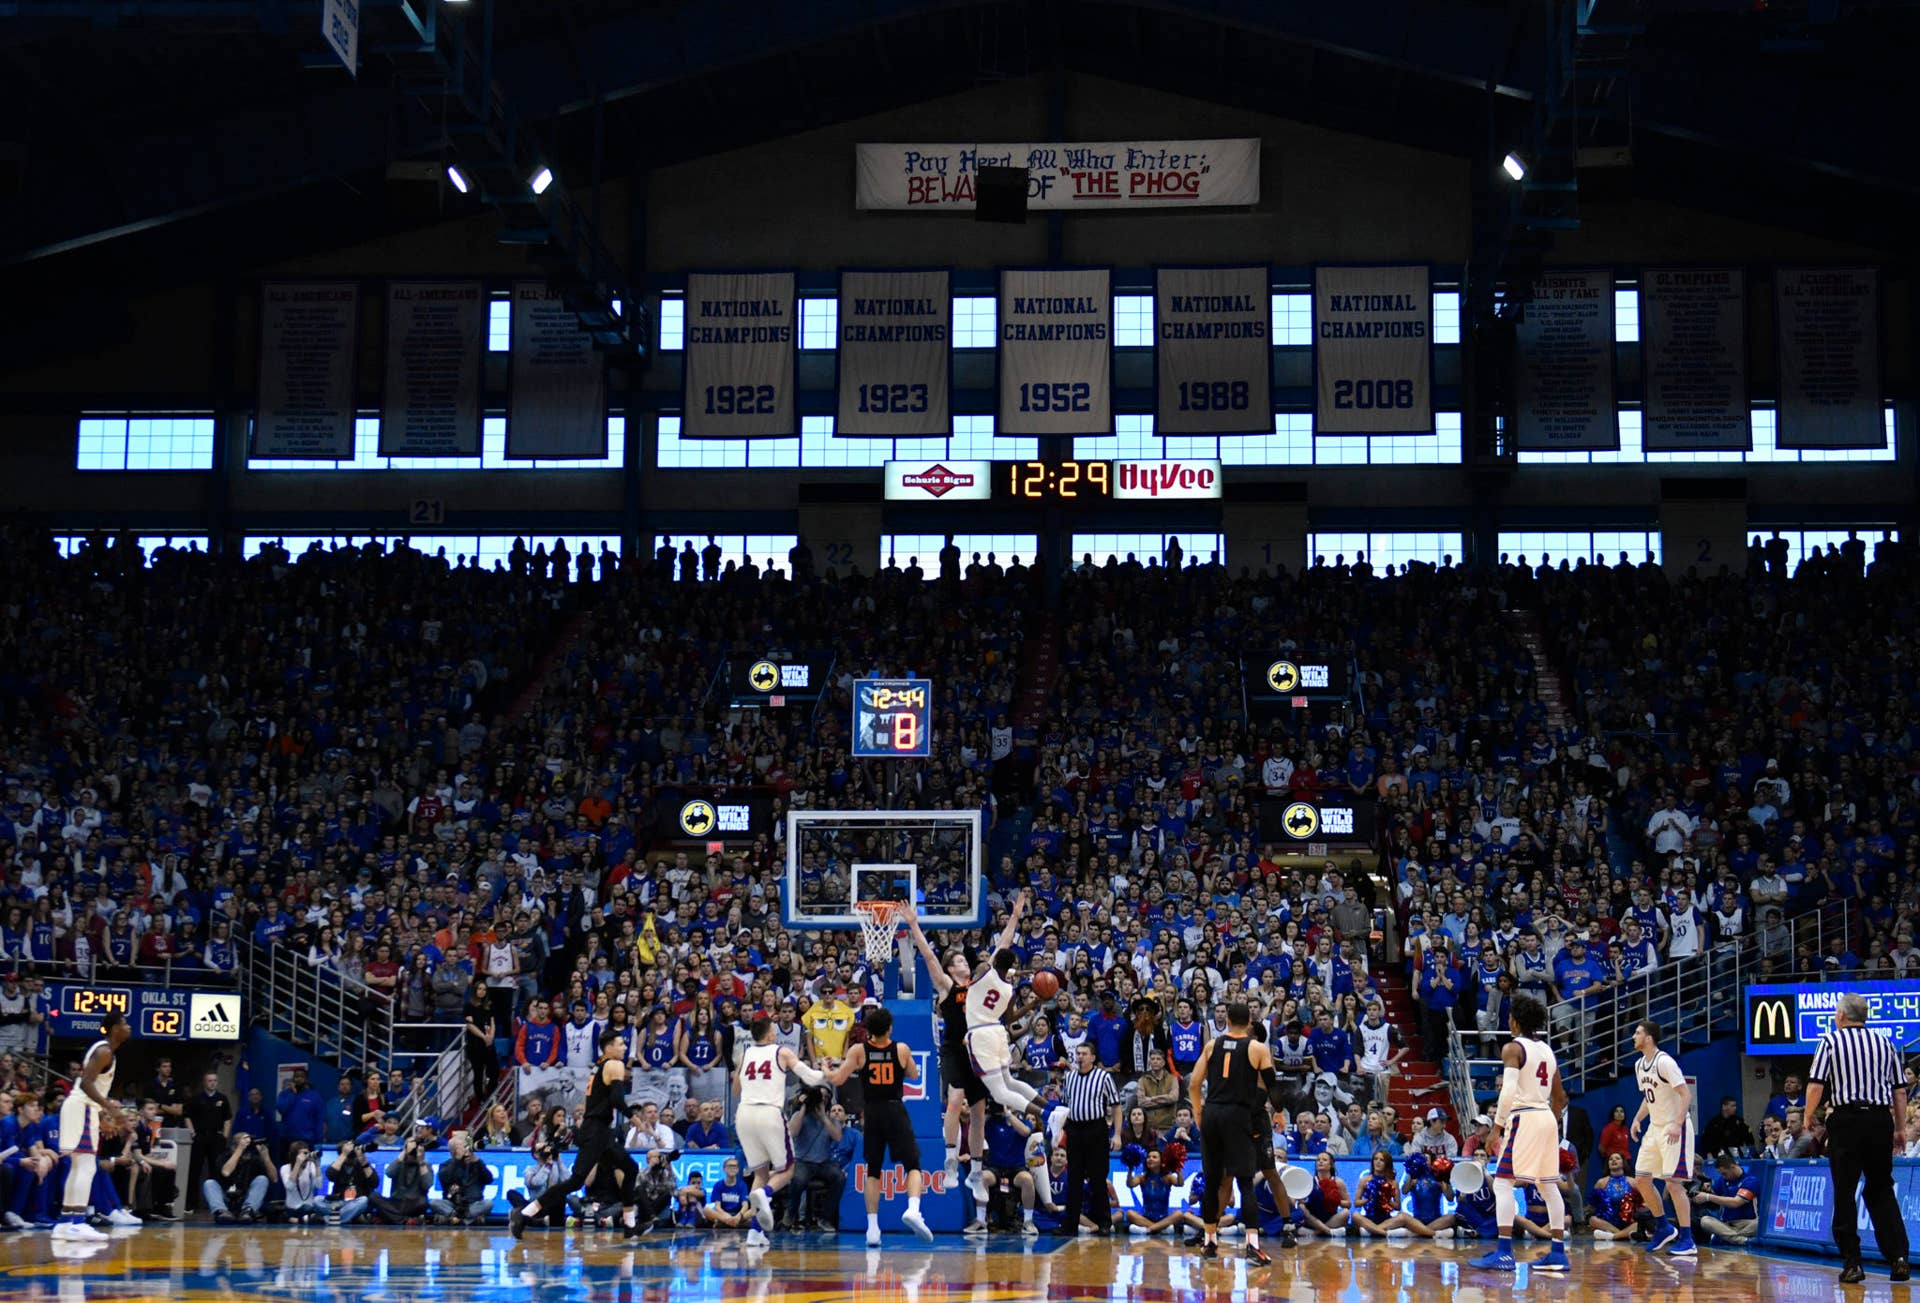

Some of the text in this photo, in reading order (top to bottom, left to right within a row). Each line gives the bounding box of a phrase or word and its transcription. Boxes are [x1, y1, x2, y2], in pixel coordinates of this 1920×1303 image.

[700, 300, 783, 317] NATIONAL
[853, 299, 938, 316] NATIONAL
[1013, 296, 1097, 314] NATIONAL
[1171, 295, 1255, 312] NATIONAL
[1330, 294, 1416, 311] NATIONAL
[689, 325, 791, 344] CHAMPIONS
[844, 324, 946, 342] CHAMPIONS
[1003, 323, 1107, 341] CHAMPIONS
[1161, 321, 1265, 339] CHAMPIONS
[1320, 320, 1425, 338] CHAMPIONS
[704, 384, 775, 415] 1922
[858, 383, 929, 413] 1923
[1019, 382, 1090, 412] 1952
[1178, 381, 1249, 410] 1988
[1334, 380, 1413, 409] 2008
[1011, 462, 1108, 497] 12:29
[416, 500, 440, 520] 21
[826, 543, 852, 564] 22
[1697, 539, 1711, 561] 2
[781, 679, 809, 687] WINGS
[782, 671, 809, 680] WILD
[1301, 671, 1329, 680] WILD
[1301, 679, 1329, 688] WINGS
[873, 688, 925, 710] 12:44
[895, 712, 917, 750] 8
[996, 737, 1008, 748] 35
[1273, 771, 1285, 782] 34
[424, 808, 437, 817] 15
[717, 811, 750, 822] WILD
[1321, 814, 1354, 824] WILD
[1578, 808, 1584, 817] 4
[717, 821, 750, 831] WINGS
[1321, 823, 1354, 834] WINGS
[117, 944, 125, 956] 2
[217, 951, 231, 964] 34
[74, 991, 127, 1013] 12:44
[141, 993, 187, 1006] OKLA. ST.
[983, 989, 1000, 1011] 2
[152, 1011, 179, 1034] 62
[195, 1022, 236, 1033] adidas
[1896, 1026, 1904, 1039] 2
[535, 1040, 541, 1054] 1
[573, 1042, 580, 1053] 4
[652, 1047, 662, 1062] 0
[695, 1046, 708, 1060] 11
[1179, 1041, 1194, 1052] 34
[1369, 1043, 1377, 1055] 4
[1032, 1054, 1048, 1069] 21
[1222, 1051, 1231, 1079] 1
[745, 1060, 772, 1081] 44
[868, 1062, 895, 1085] 30
[1535, 1060, 1549, 1087] 4
[1791, 1176, 1826, 1207] SHELTER
[1786, 1210, 1822, 1232] INSURANCE
